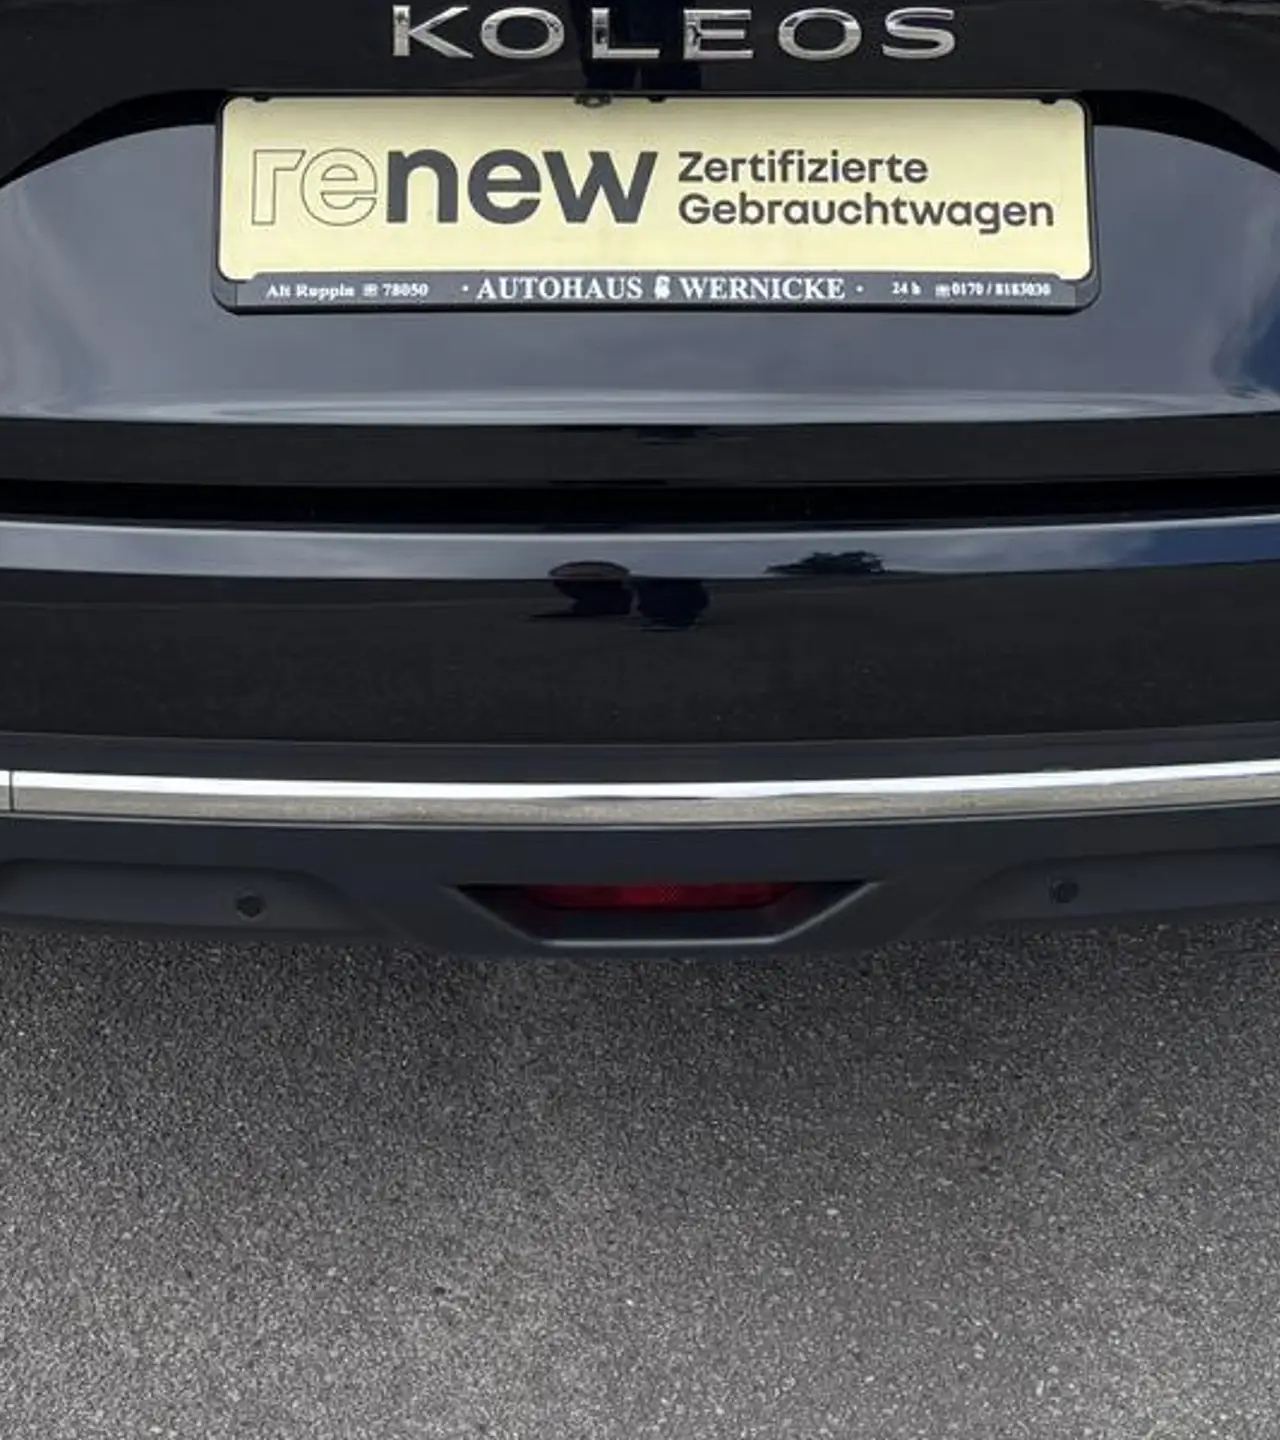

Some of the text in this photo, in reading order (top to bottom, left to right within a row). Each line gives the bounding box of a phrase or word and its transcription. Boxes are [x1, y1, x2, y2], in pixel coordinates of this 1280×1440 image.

[392, 4, 957, 61] KOLEOS
[251, 148, 659, 227] renew
[677, 149, 929, 184] Zertifizierte
[677, 191, 1054, 235] Gebrauchtwagen
[296, 282, 357, 302] Ruppin
[476, 277, 643, 301] AUTOHAUS
[680, 276, 846, 300] WERNICKE
